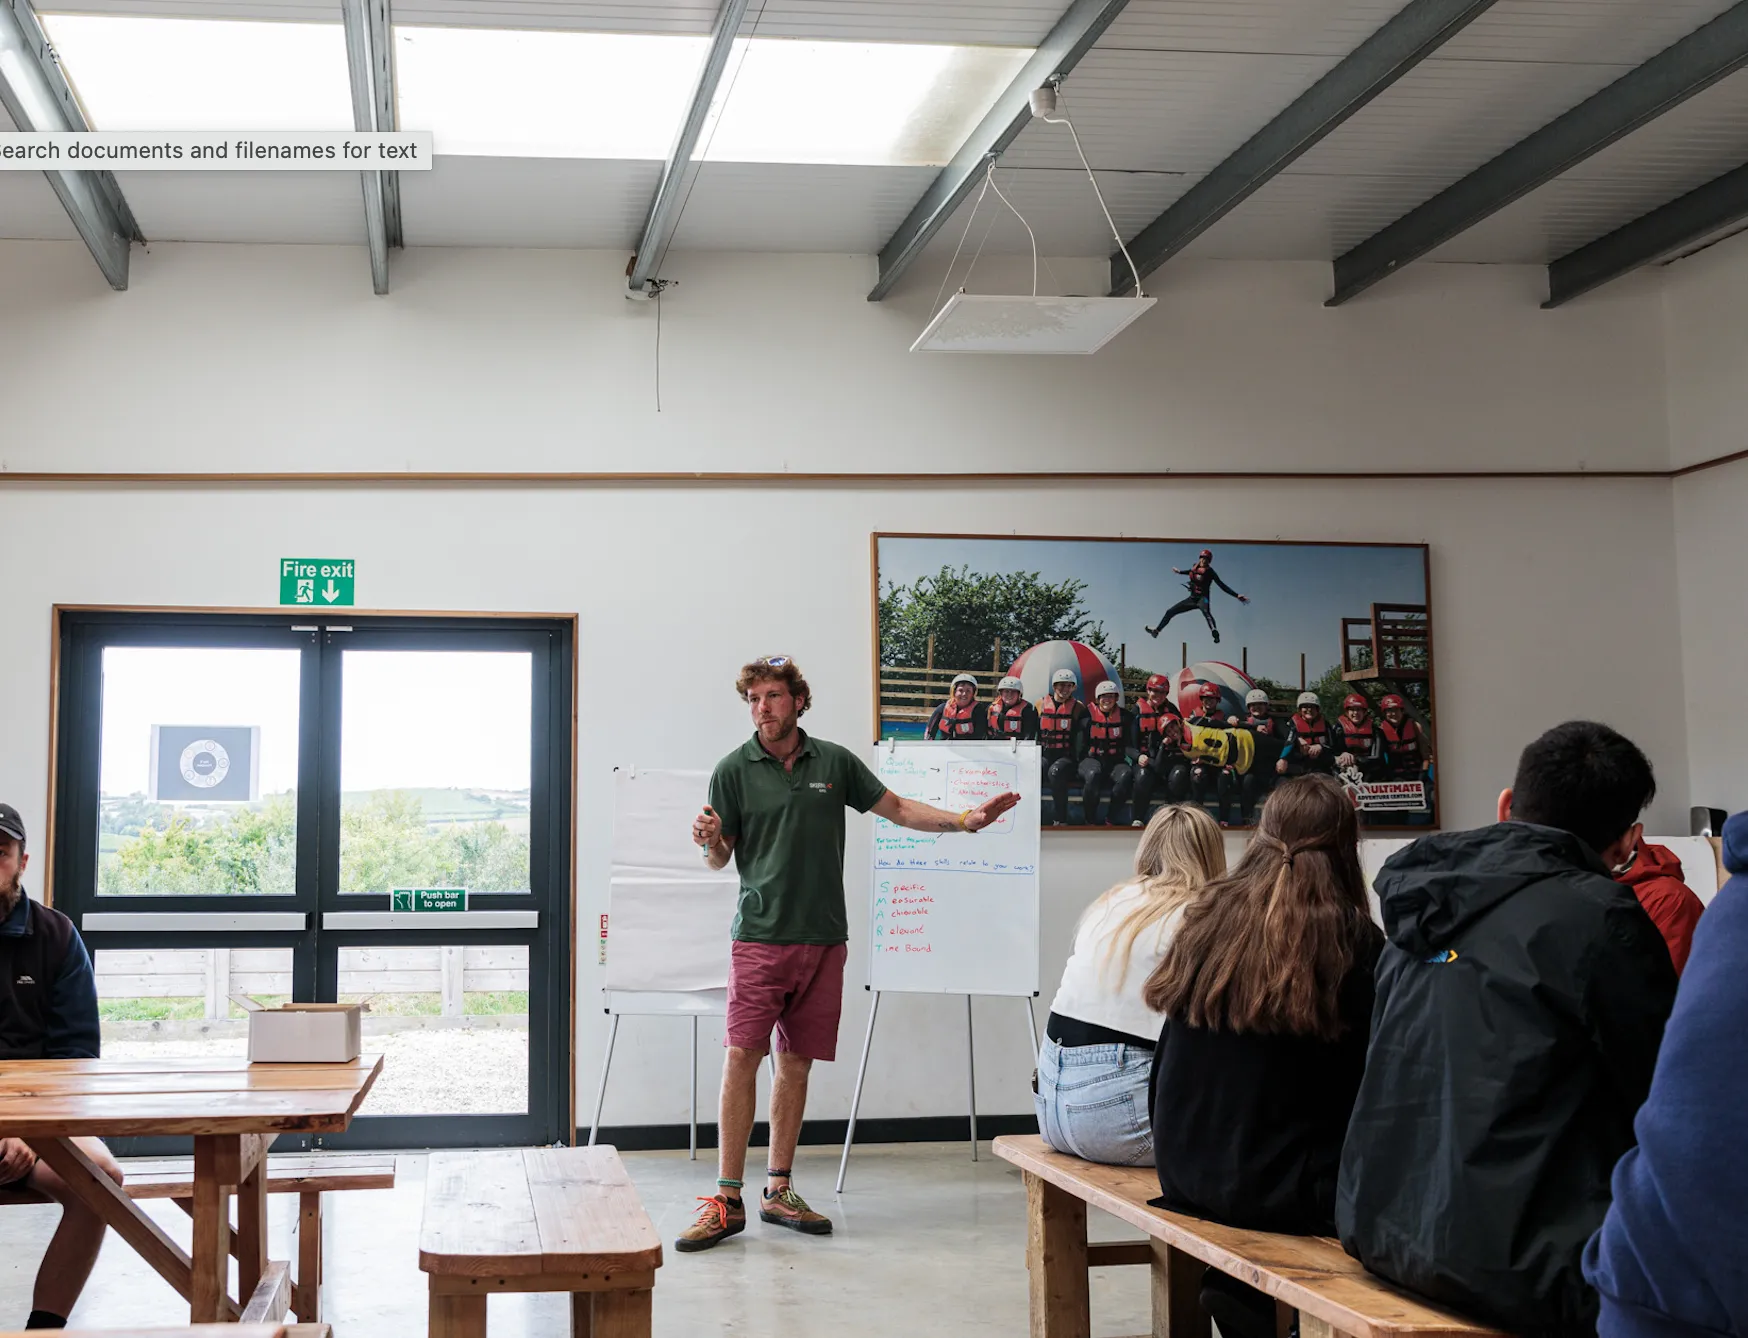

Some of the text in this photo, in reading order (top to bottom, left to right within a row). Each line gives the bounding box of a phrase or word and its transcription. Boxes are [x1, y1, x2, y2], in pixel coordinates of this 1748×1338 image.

[283, 560, 353, 578] Fire exit
[958, 768, 998, 777] Examples
[896, 858, 905, 866] do
[982, 859, 989, 867] to
[421, 891, 459, 899] Push bar
[423, 900, 457, 909] to open
[905, 943, 932, 953] Bound
